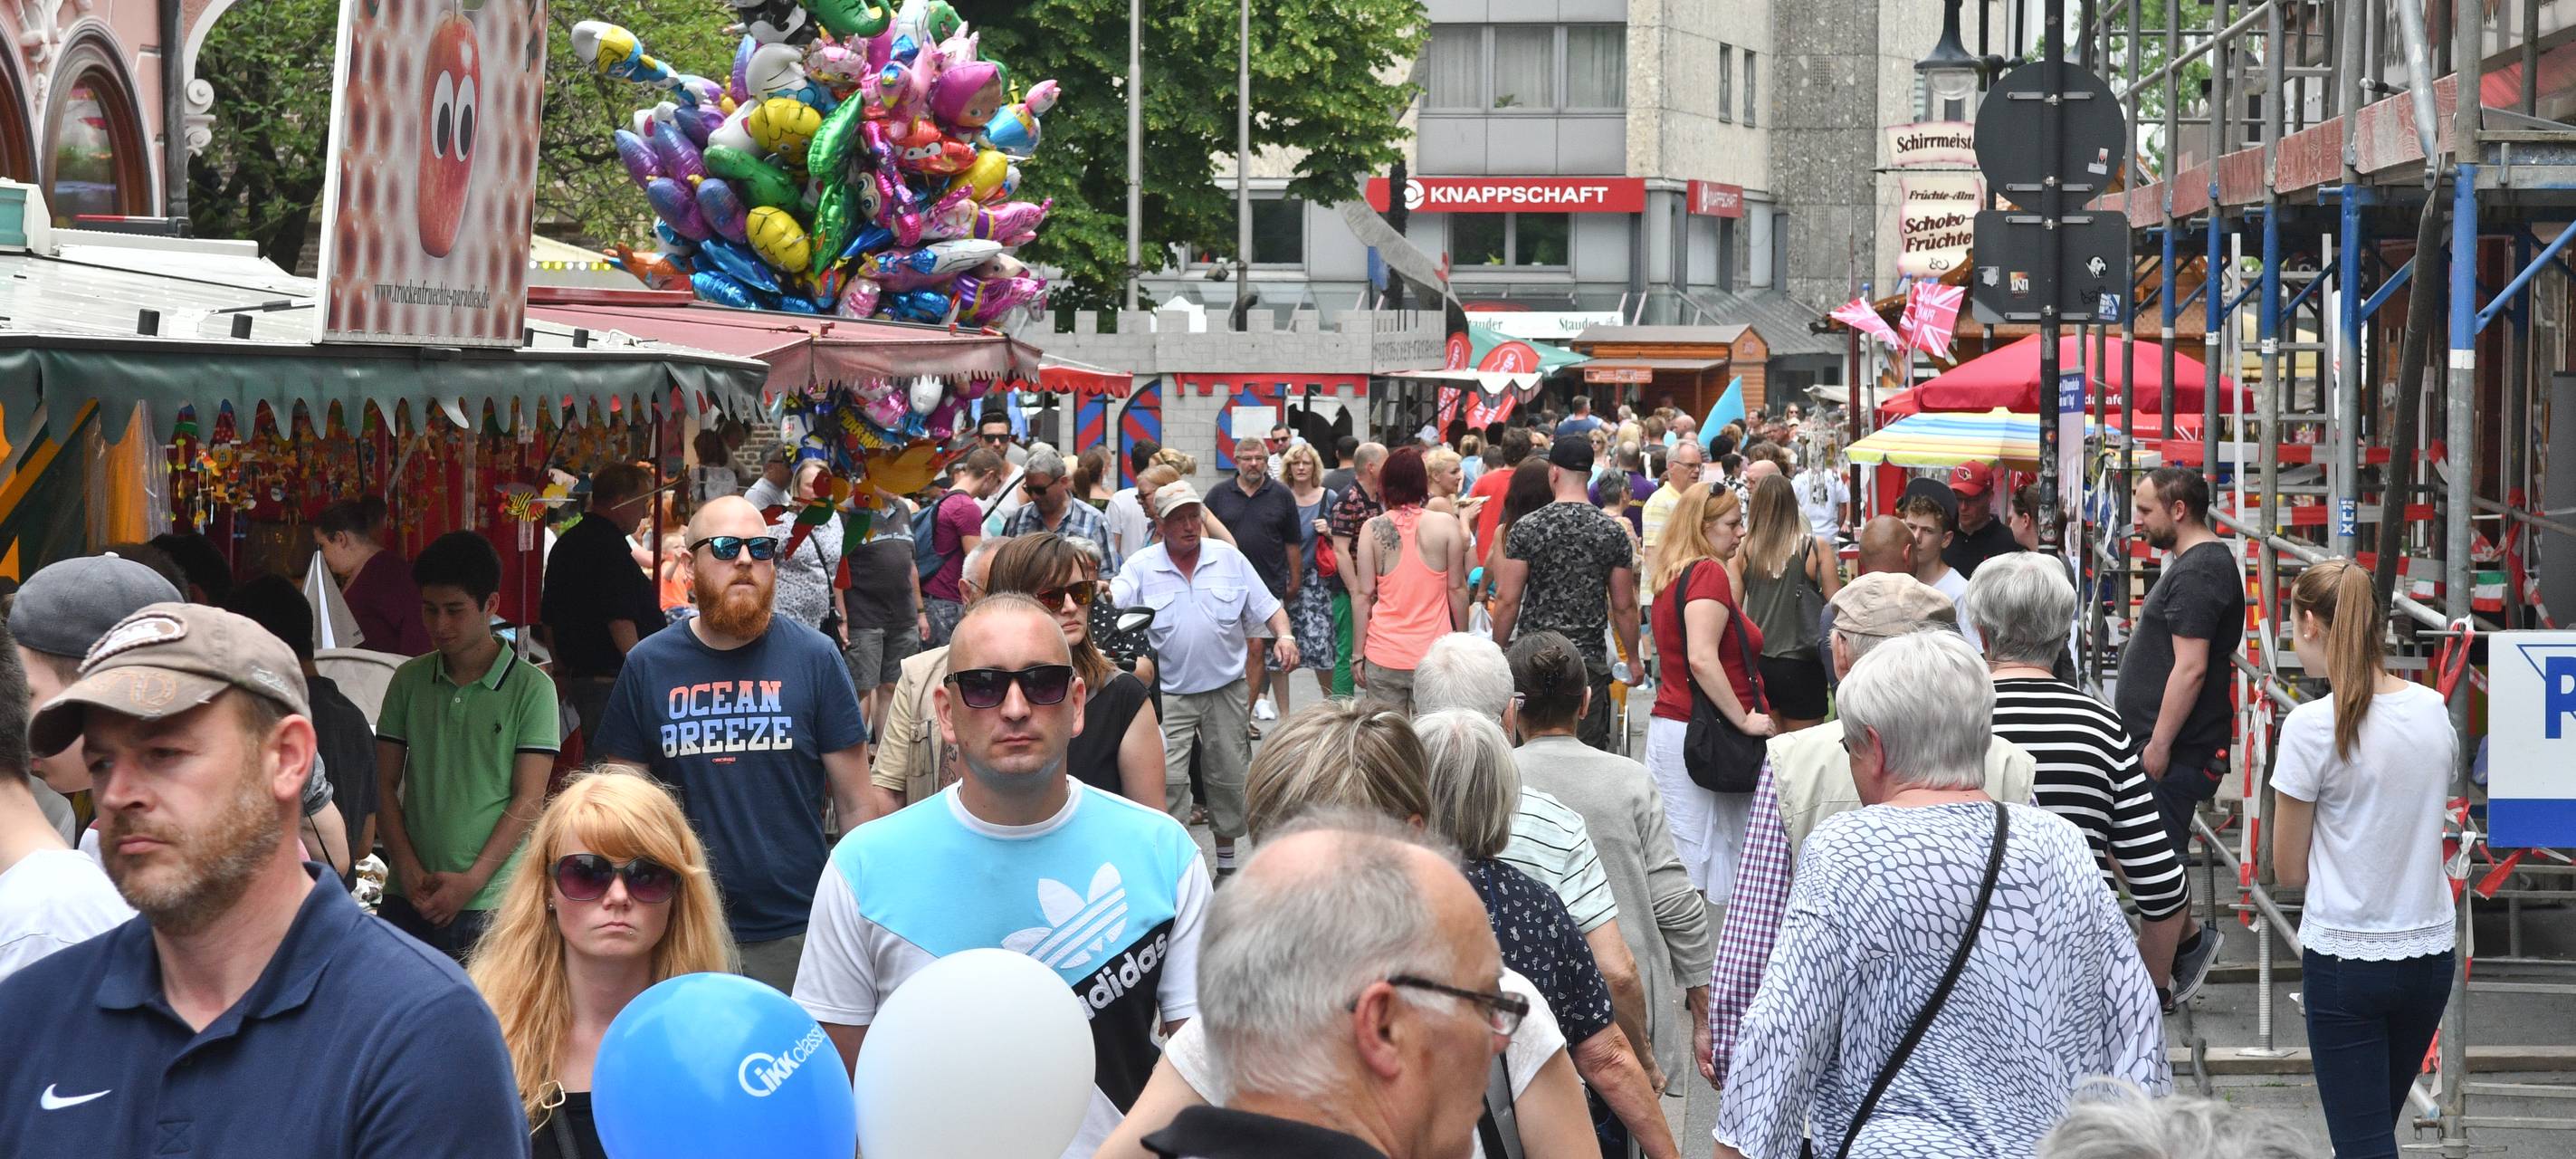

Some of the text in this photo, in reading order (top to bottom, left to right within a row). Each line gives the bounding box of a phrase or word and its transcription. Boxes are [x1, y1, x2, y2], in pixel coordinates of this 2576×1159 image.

[1896, 133, 1975, 154] Schirrmeist
[1429, 186, 1609, 205] KNAPPSCHAFT
[1904, 231, 1972, 254] Früchte
[373, 279, 491, 314] www.trockenfruechte-paradies.de
[668, 680, 782, 720] OCEAN
[660, 715, 794, 759] BREEZE
